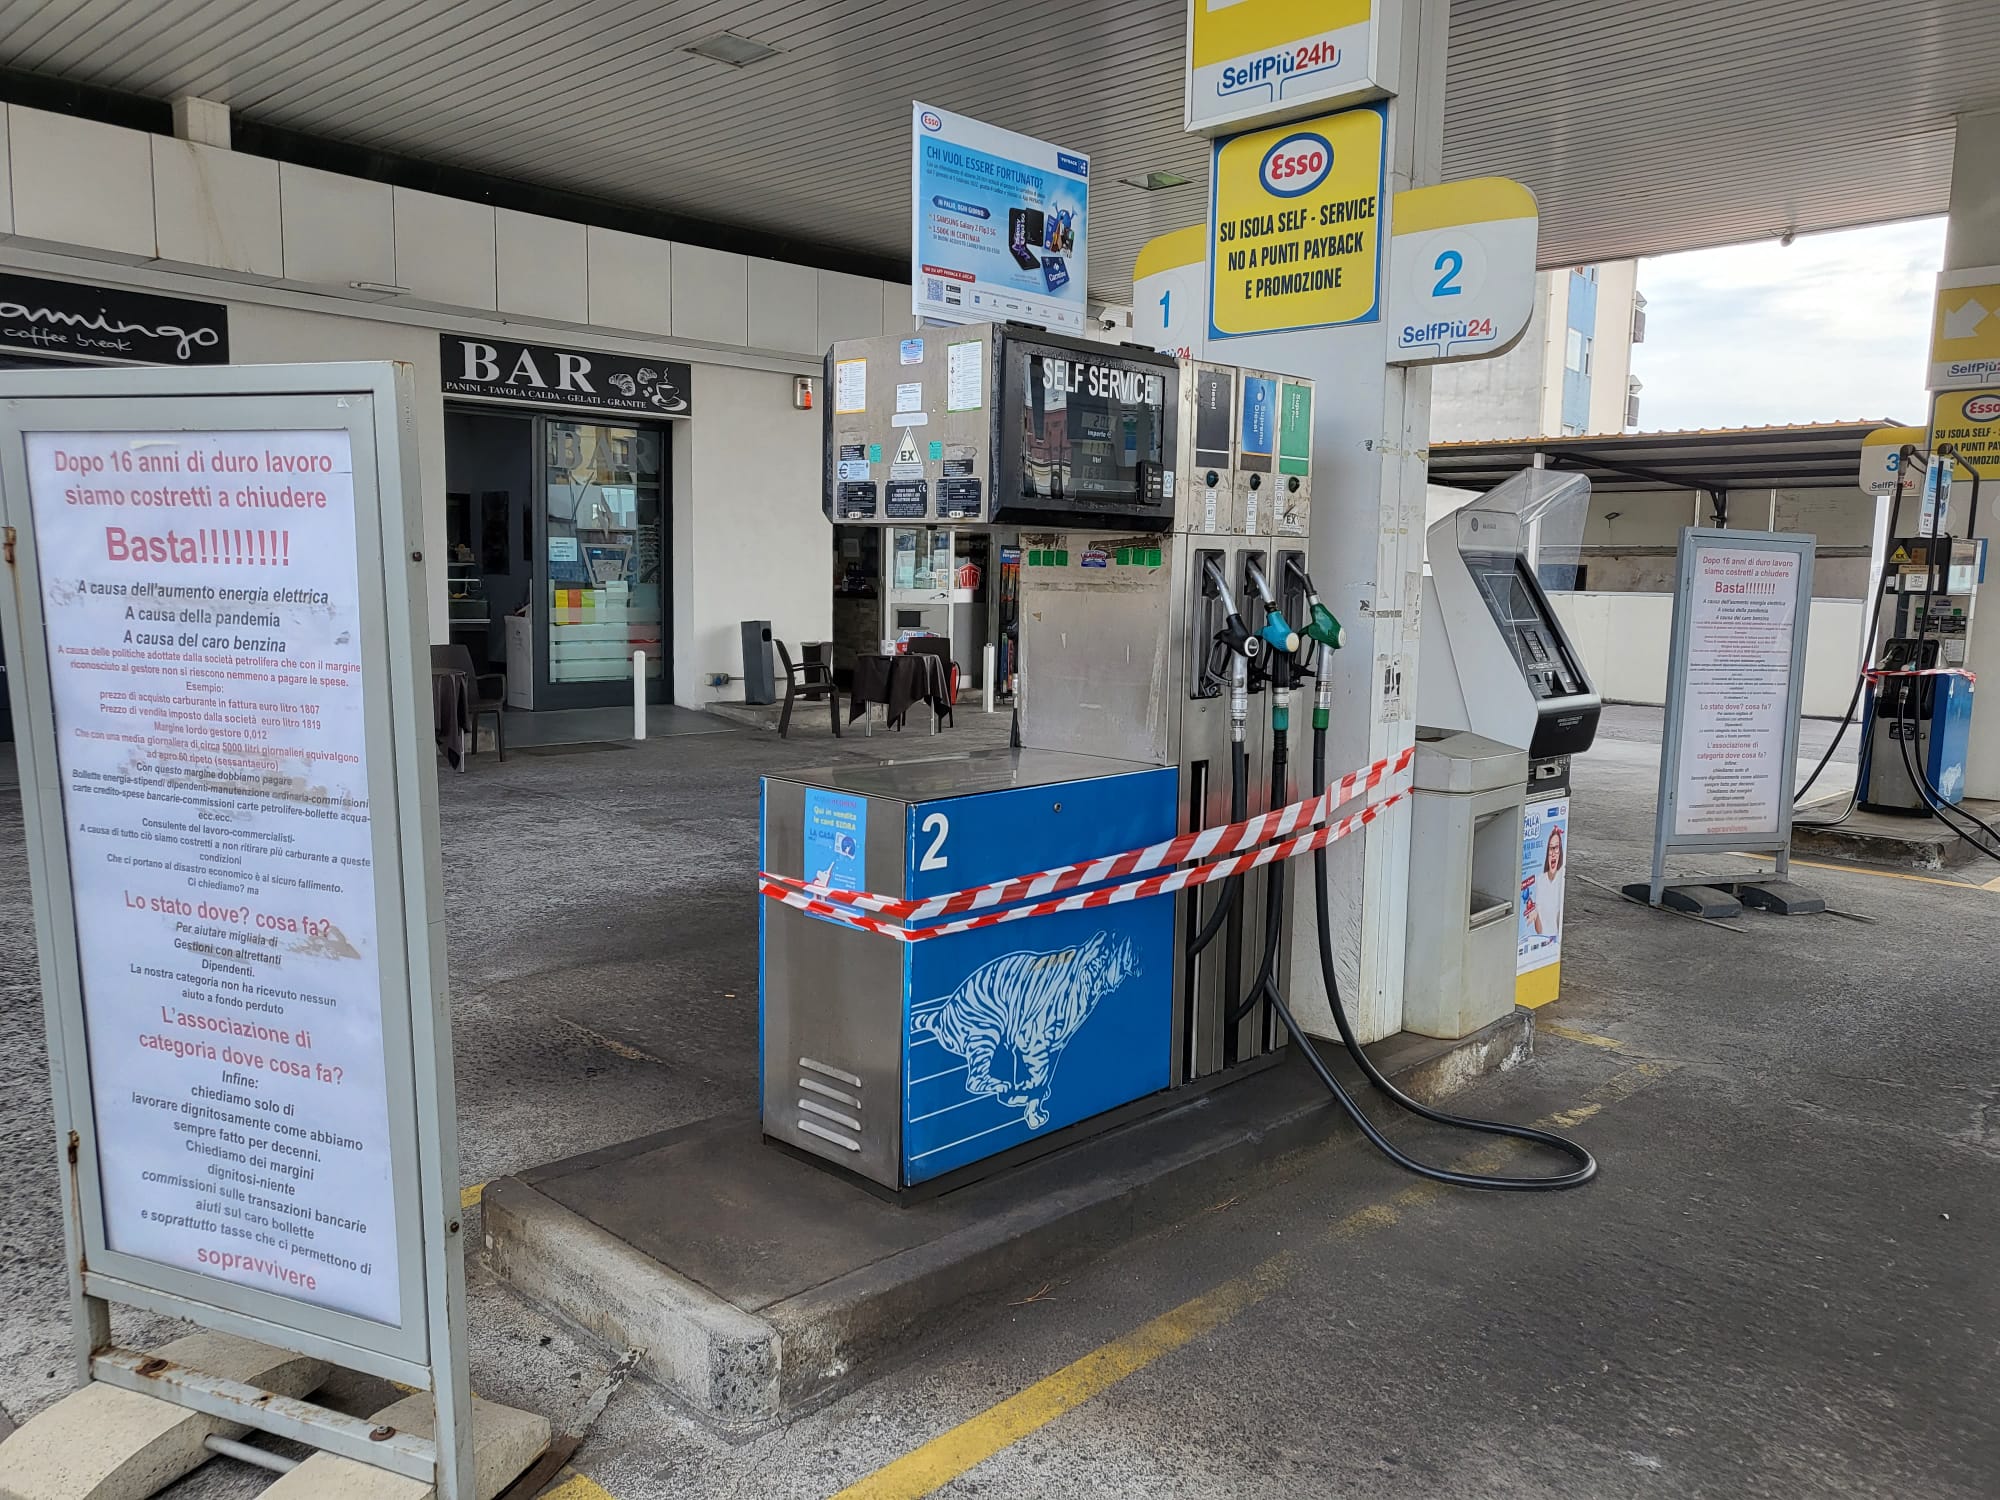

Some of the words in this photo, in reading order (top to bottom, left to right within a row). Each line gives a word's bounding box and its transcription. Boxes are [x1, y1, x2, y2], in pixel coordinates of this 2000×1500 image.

[1222, 41, 1336, 90] SelfPiù24h
[927, 146, 940, 160] CHI
[943, 150, 963, 166] VUOL
[966, 157, 994, 175] ESSERE
[997, 166, 1044, 190] FORTUNATO?
[1271, 151, 1323, 180] Esso
[1220, 221, 1236, 242] SU
[1240, 215, 1274, 239] ISOLA
[1278, 209, 1307, 232] SELF
[1320, 196, 1376, 226] SERVICE
[1228, 250, 1245, 271] NO
[1249, 248, 1257, 268] A
[1261, 242, 1299, 266] PUNTI
[1304, 231, 1364, 260] PAYBACK
[1245, 280, 1252, 299] E
[1256, 267, 1342, 298] PROMOZIONE
[1432, 250, 1463, 297] 2
[1159, 290, 1171, 328] 1
[4, 326, 68, 346] coffee
[76, 334, 132, 351] break
[1403, 318, 1492, 343] SelfPiù24
[458, 341, 597, 393] BAR
[1042, 358, 1084, 393] SELF
[1088, 366, 1154, 404] SERVICE
[446, 381, 481, 392] PANINI
[488, 386, 526, 397] TAVOLA
[528, 390, 560, 400] CALDA
[567, 394, 600, 404] GELATI
[608, 398, 647, 409] GRANITE
[1935, 430, 1945, 439] SU
[1948, 428, 1970, 438] ISOLA
[1972, 428, 1991, 437] SELF
[1961, 442, 1985, 451] PUNTI
[54, 450, 104, 477] Dopo
[109, 450, 133, 472] 16
[135, 448, 180, 473] anni
[186, 450, 205, 473] di
[210, 450, 258, 473] duro
[265, 450, 332, 475] lavoro
[901, 451, 914, 461] EX
[1886, 453, 1900, 472] 3
[64, 483, 125, 506] siamo
[130, 485, 212, 507] costretti
[218, 490, 230, 507] a
[235, 485, 326, 508] chiudere
[1871, 480, 1913, 489] SelfPi24
[1287, 514, 1296, 524] EX
[76, 579, 87, 594] A
[89, 582, 127, 596] causa
[130, 581, 215, 600] dell'aumento
[218, 586, 269, 605] energia
[272, 587, 328, 605] elettrica
[124, 605, 135, 620] A
[137, 608, 176, 622] causa
[178, 608, 212, 624] della
[215, 610, 280, 627] pandemia
[122, 629, 133, 644] A
[135, 633, 174, 646] causa
[177, 632, 198, 648] del
[201, 636, 230, 650] caro
[233, 635, 286, 652] benzina
[185, 680, 224, 694] Esempio:
[920, 813, 949, 871] 2
[124, 889, 146, 910] Lo
[150, 895, 192, 916] stato
[197, 900, 250, 925] dove?
[255, 913, 298, 933] cosa
[301, 915, 333, 938] fa?
[161, 1006, 289, 1044] L'associazione
[294, 1029, 312, 1049] di
[138, 1034, 216, 1060] categoria
[221, 1045, 264, 1069] dove
[269, 1058, 311, 1079] cosa
[315, 1062, 343, 1085] fa?
[221, 1070, 258, 1089] Infine:
[191, 1084, 251, 1107] chiediamo
[253, 1099, 280, 1113] solo
[282, 1103, 295, 1117] di
[131, 1091, 178, 1112] lavorare
[180, 1102, 271, 1131] dignitosamente
[273, 1123, 307, 1139] come
[309, 1129, 363, 1151] abbiamo
[173, 1121, 216, 1138] sempre
[218, 1128, 245, 1145] fatto
[248, 1137, 269, 1150] per
[270, 1140, 321, 1162] decenni.
[141, 1170, 216, 1194] commissioni
[218, 1186, 245, 1202] sulle
[247, 1193, 312, 1219] transazioni
[314, 1209, 367, 1234] bancarie
[140, 1209, 148, 1219] e
[150, 1211, 217, 1232] soprattutto
[220, 1222, 252, 1240] tasse
[254, 1232, 276, 1246] che
[277, 1238, 288, 1250] ci
[290, 1243, 357, 1271] permettono
[359, 1262, 372, 1276] di
[197, 1248, 316, 1290] sopravvivere
